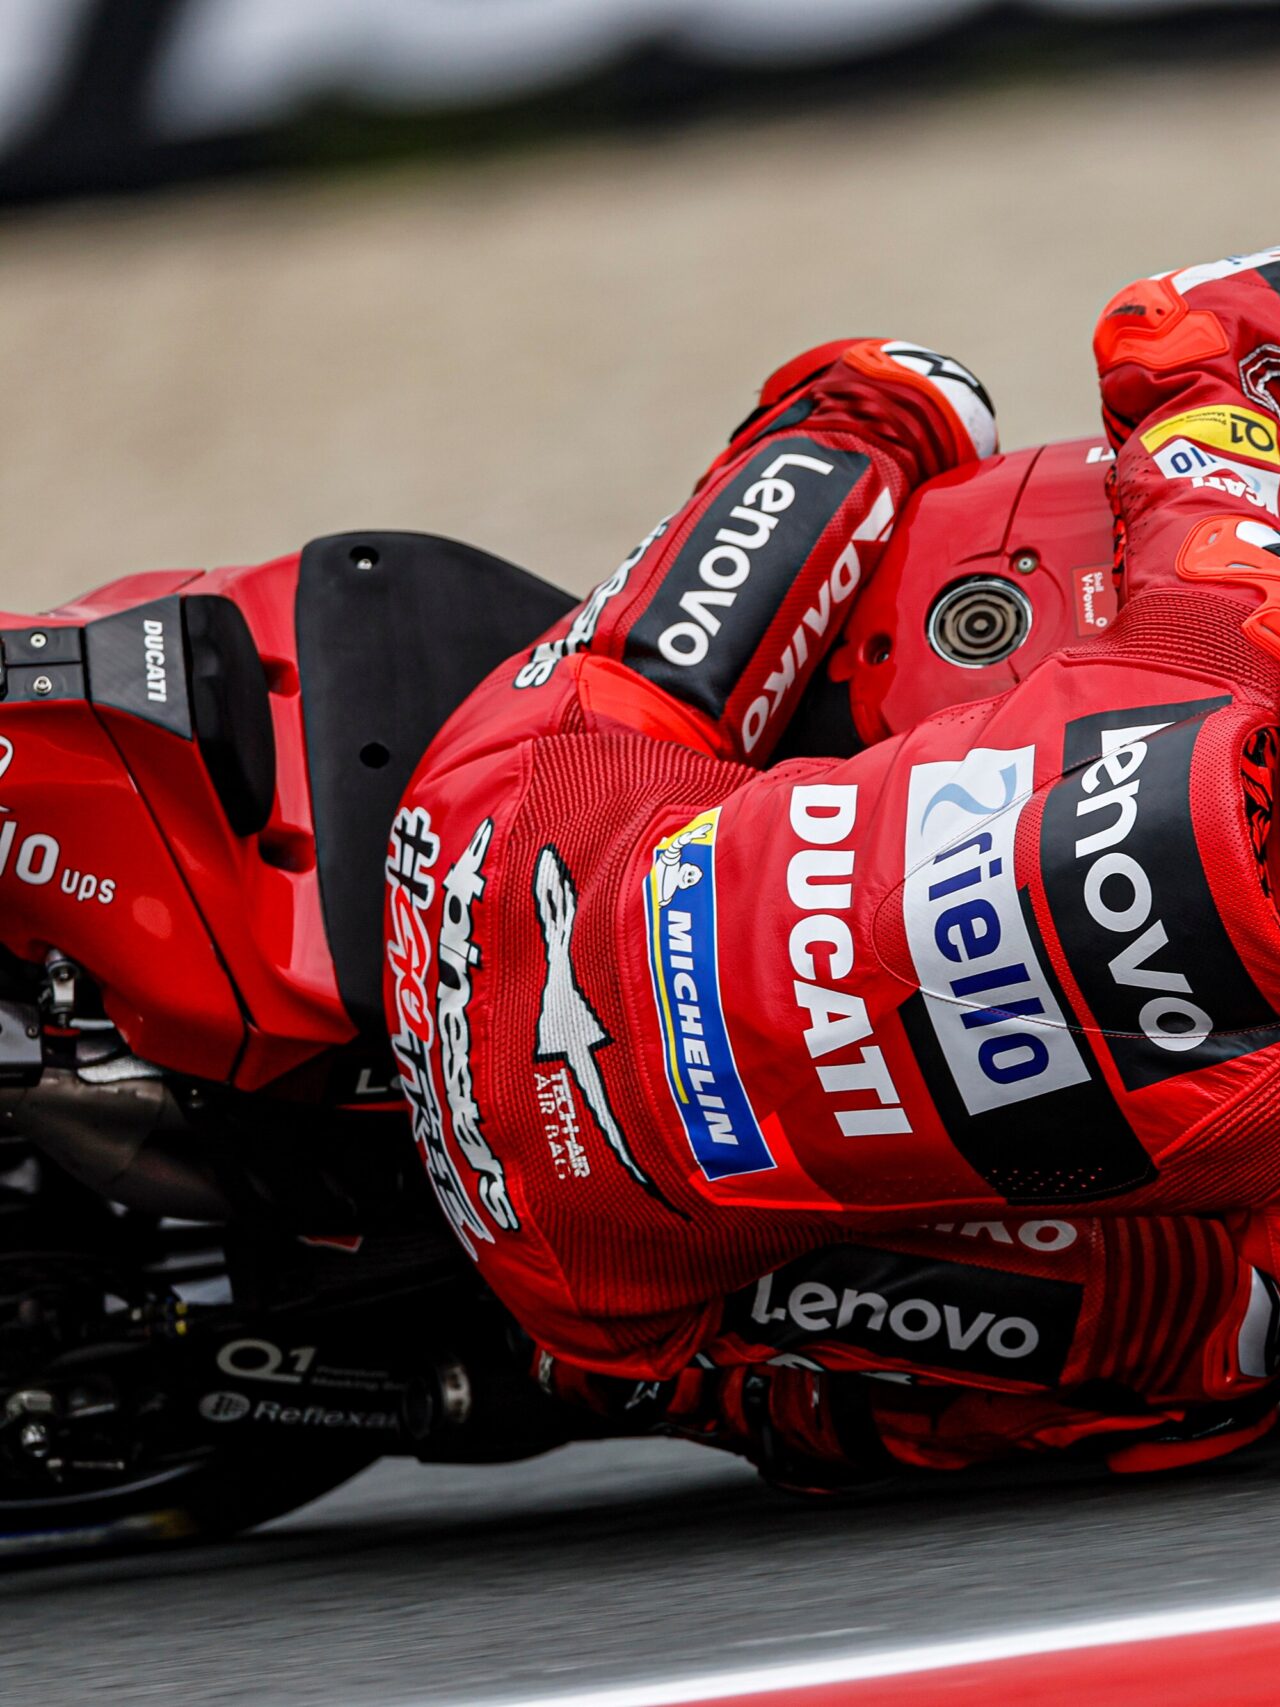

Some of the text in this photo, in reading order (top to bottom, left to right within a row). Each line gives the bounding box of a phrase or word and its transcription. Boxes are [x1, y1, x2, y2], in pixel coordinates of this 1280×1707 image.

[1230, 412, 1275, 453] Q1
[657, 453, 835, 667] Lenovo
[1081, 573, 1095, 625] V-Power
[143, 618, 168, 703] DUCATI
[61, 868, 117, 904] ups
[1075, 721, 1215, 1052] Lenovo
[785, 783, 913, 1138] DUCATI
[928, 830, 1051, 1086] riello
[666, 909, 739, 1147] MICHELIN
[751, 1271, 1040, 1359] Lenovo
[216, 1337, 317, 1384] Q1
